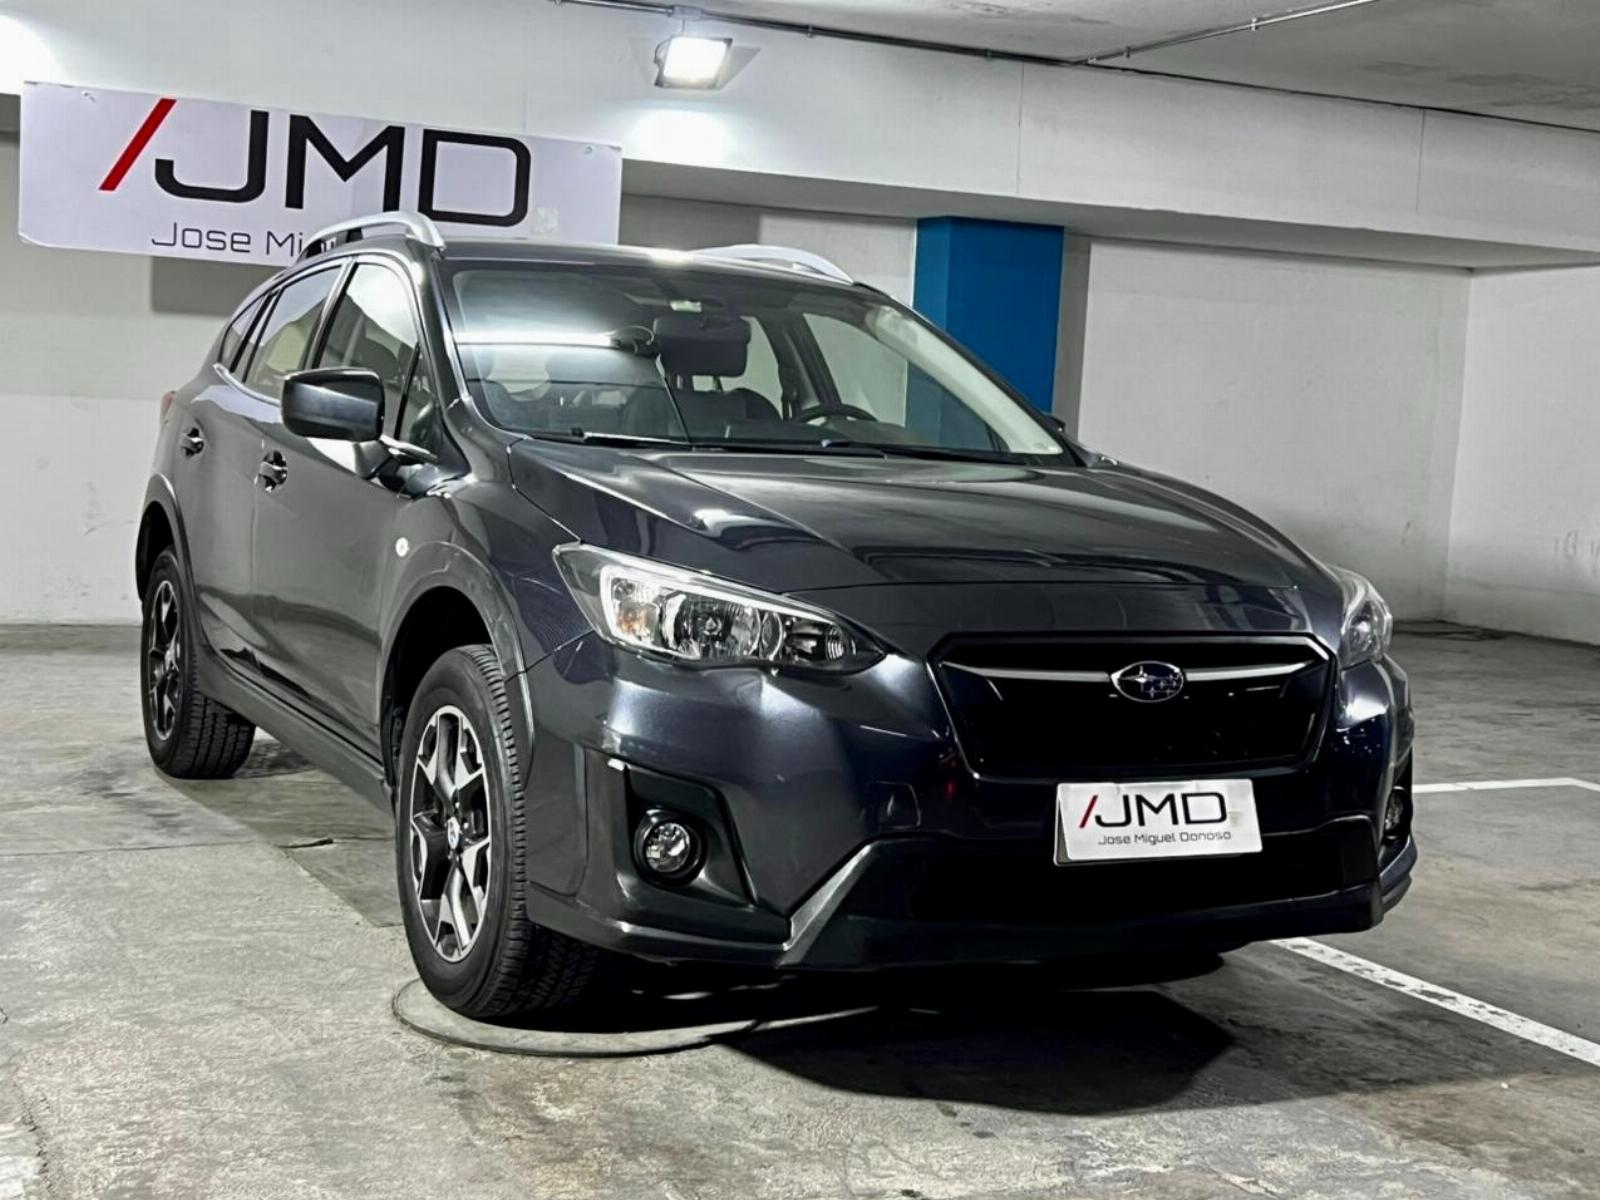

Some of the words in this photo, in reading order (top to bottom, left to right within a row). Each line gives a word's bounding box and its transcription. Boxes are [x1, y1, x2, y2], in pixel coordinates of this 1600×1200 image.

[151, 222, 252, 254] Jose
[1098, 834, 1131, 846] Jose
[1134, 832, 1176, 846] Miguel
